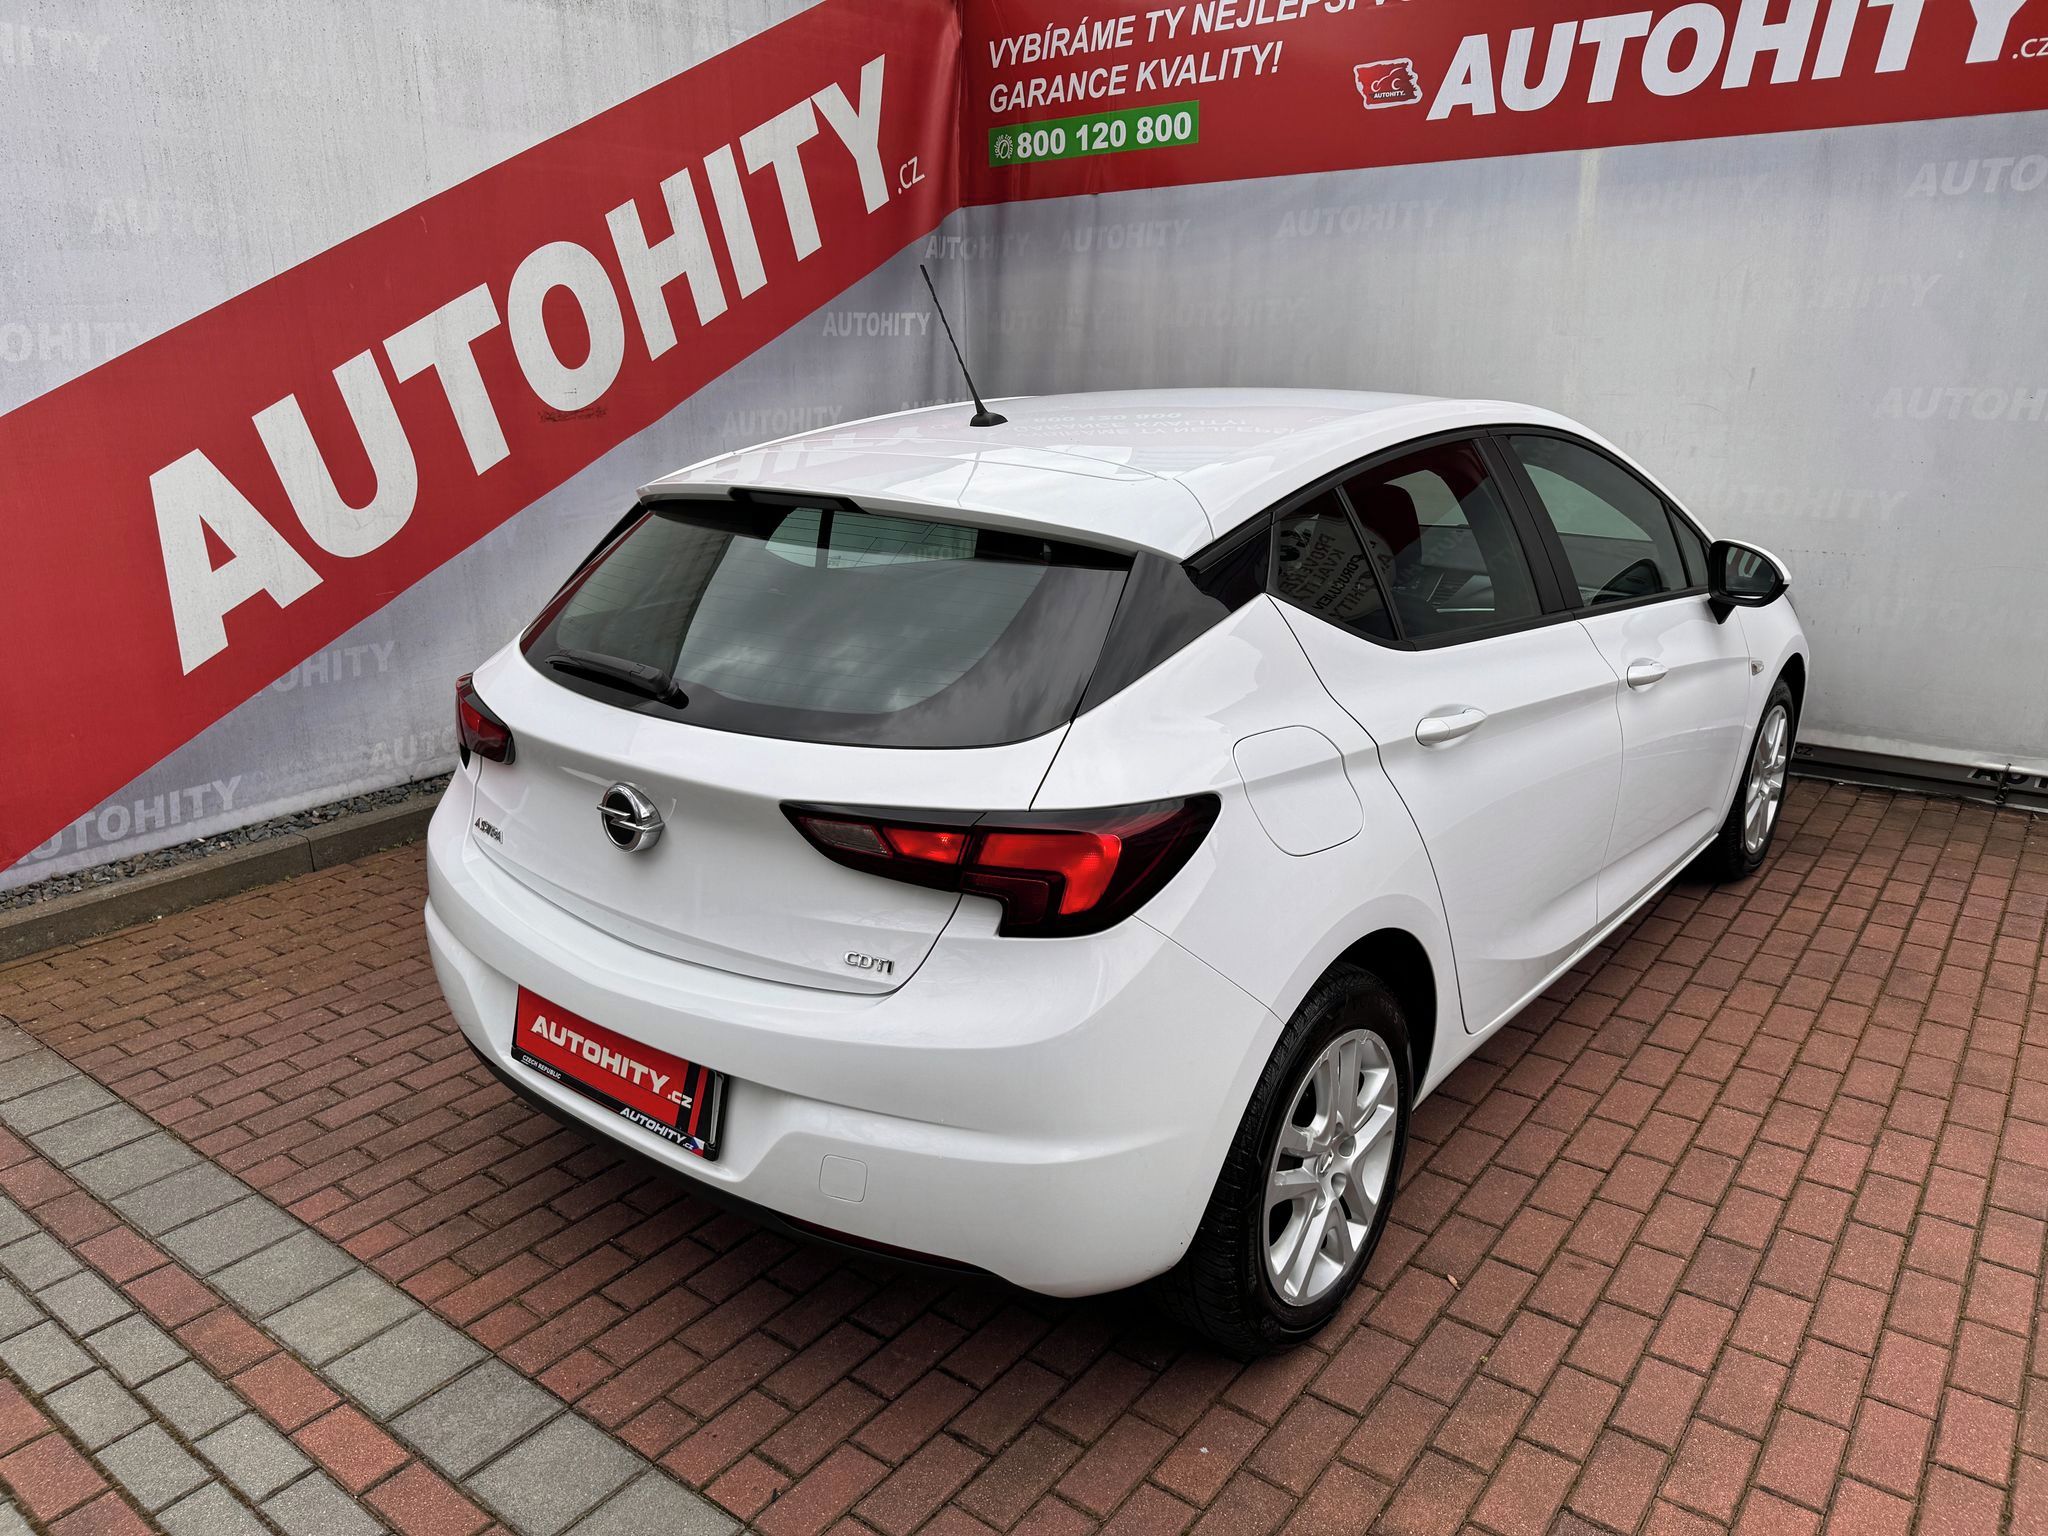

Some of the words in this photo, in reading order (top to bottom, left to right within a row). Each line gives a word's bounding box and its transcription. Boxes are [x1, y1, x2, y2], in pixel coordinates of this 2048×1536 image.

[988, 15, 1136, 69] VYBÍRÁME
[1144, 9, 1190, 43] TY
[988, 64, 1129, 114] GARANCE
[1135, 40, 1283, 93] KVALITY!
[1016, 127, 1066, 159] 800
[1075, 118, 1127, 150] 120
[1136, 111, 1192, 145] 800
[822, 310, 931, 338] AUTOHITY
[17, 774, 243, 865] UTOHITY
[844, 950, 895, 976] CDTI
[521, 1053, 539, 1068] CZECH
[537, 1063, 563, 1081] REPUBLIC
